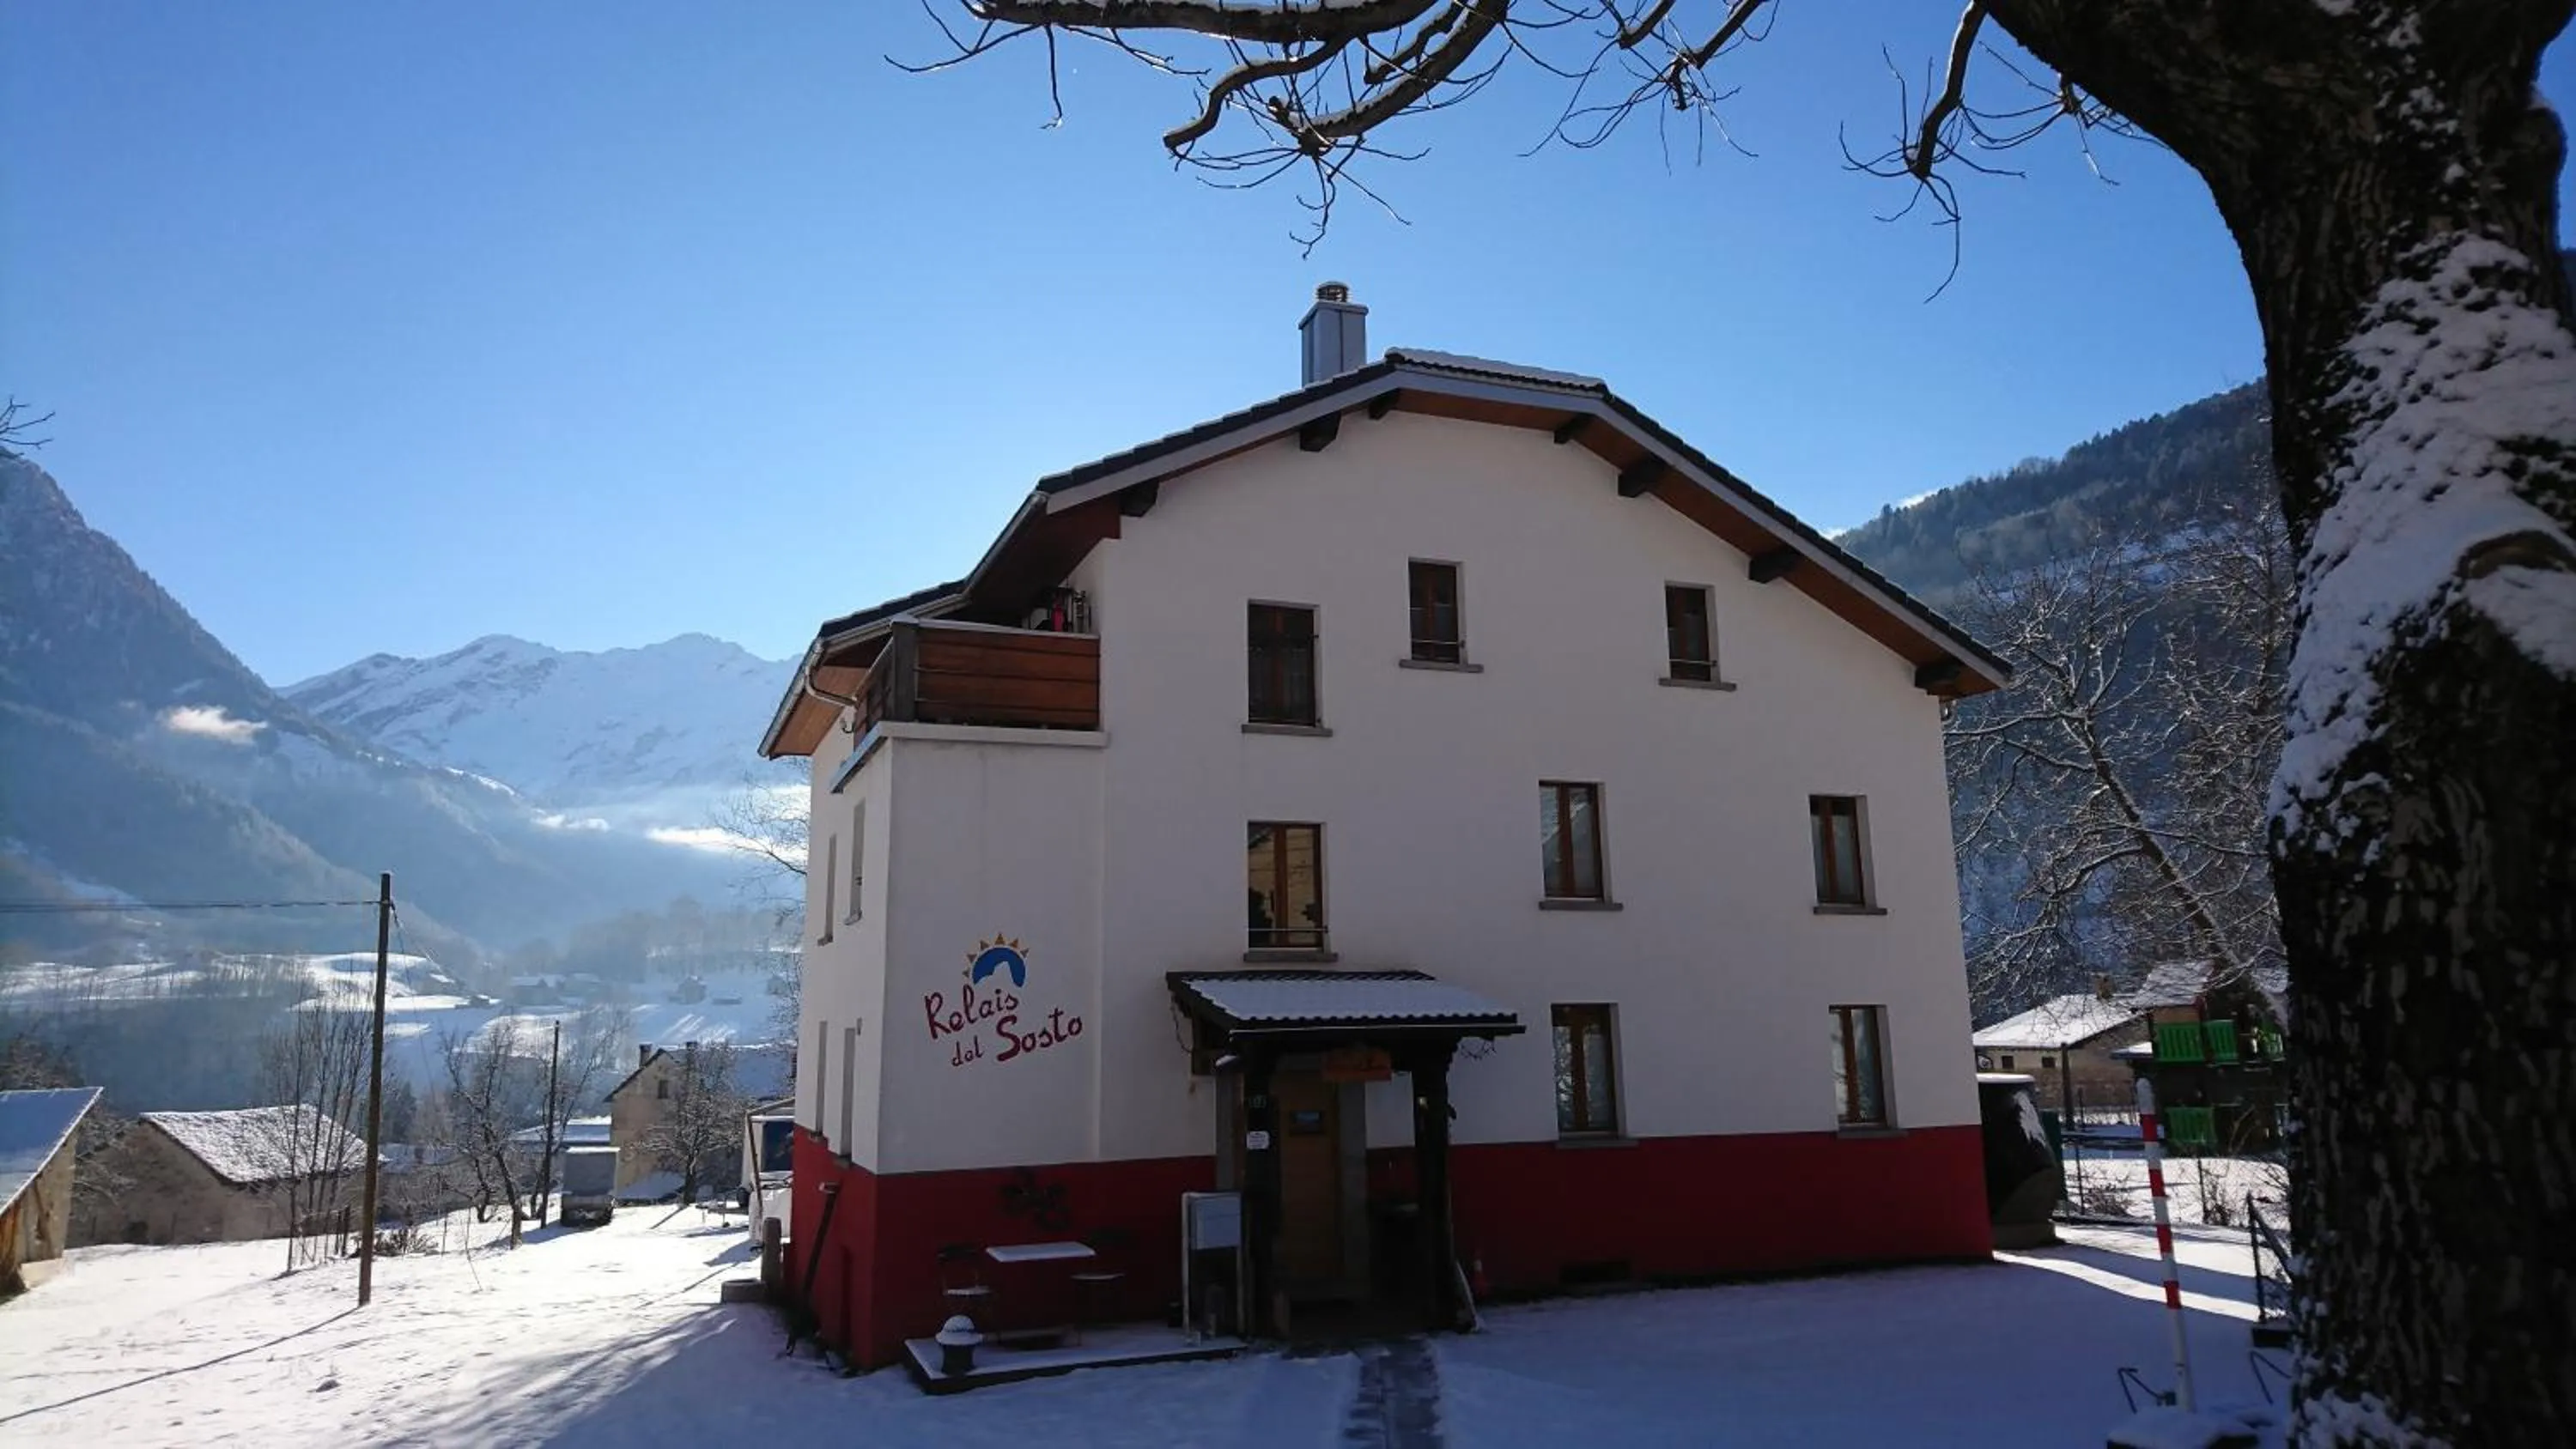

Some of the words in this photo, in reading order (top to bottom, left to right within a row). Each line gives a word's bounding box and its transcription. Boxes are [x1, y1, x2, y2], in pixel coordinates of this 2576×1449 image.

[924, 984, 1019, 1040] Relais
[951, 1035, 984, 1067] del
[995, 1007, 1084, 1062] Sosto
